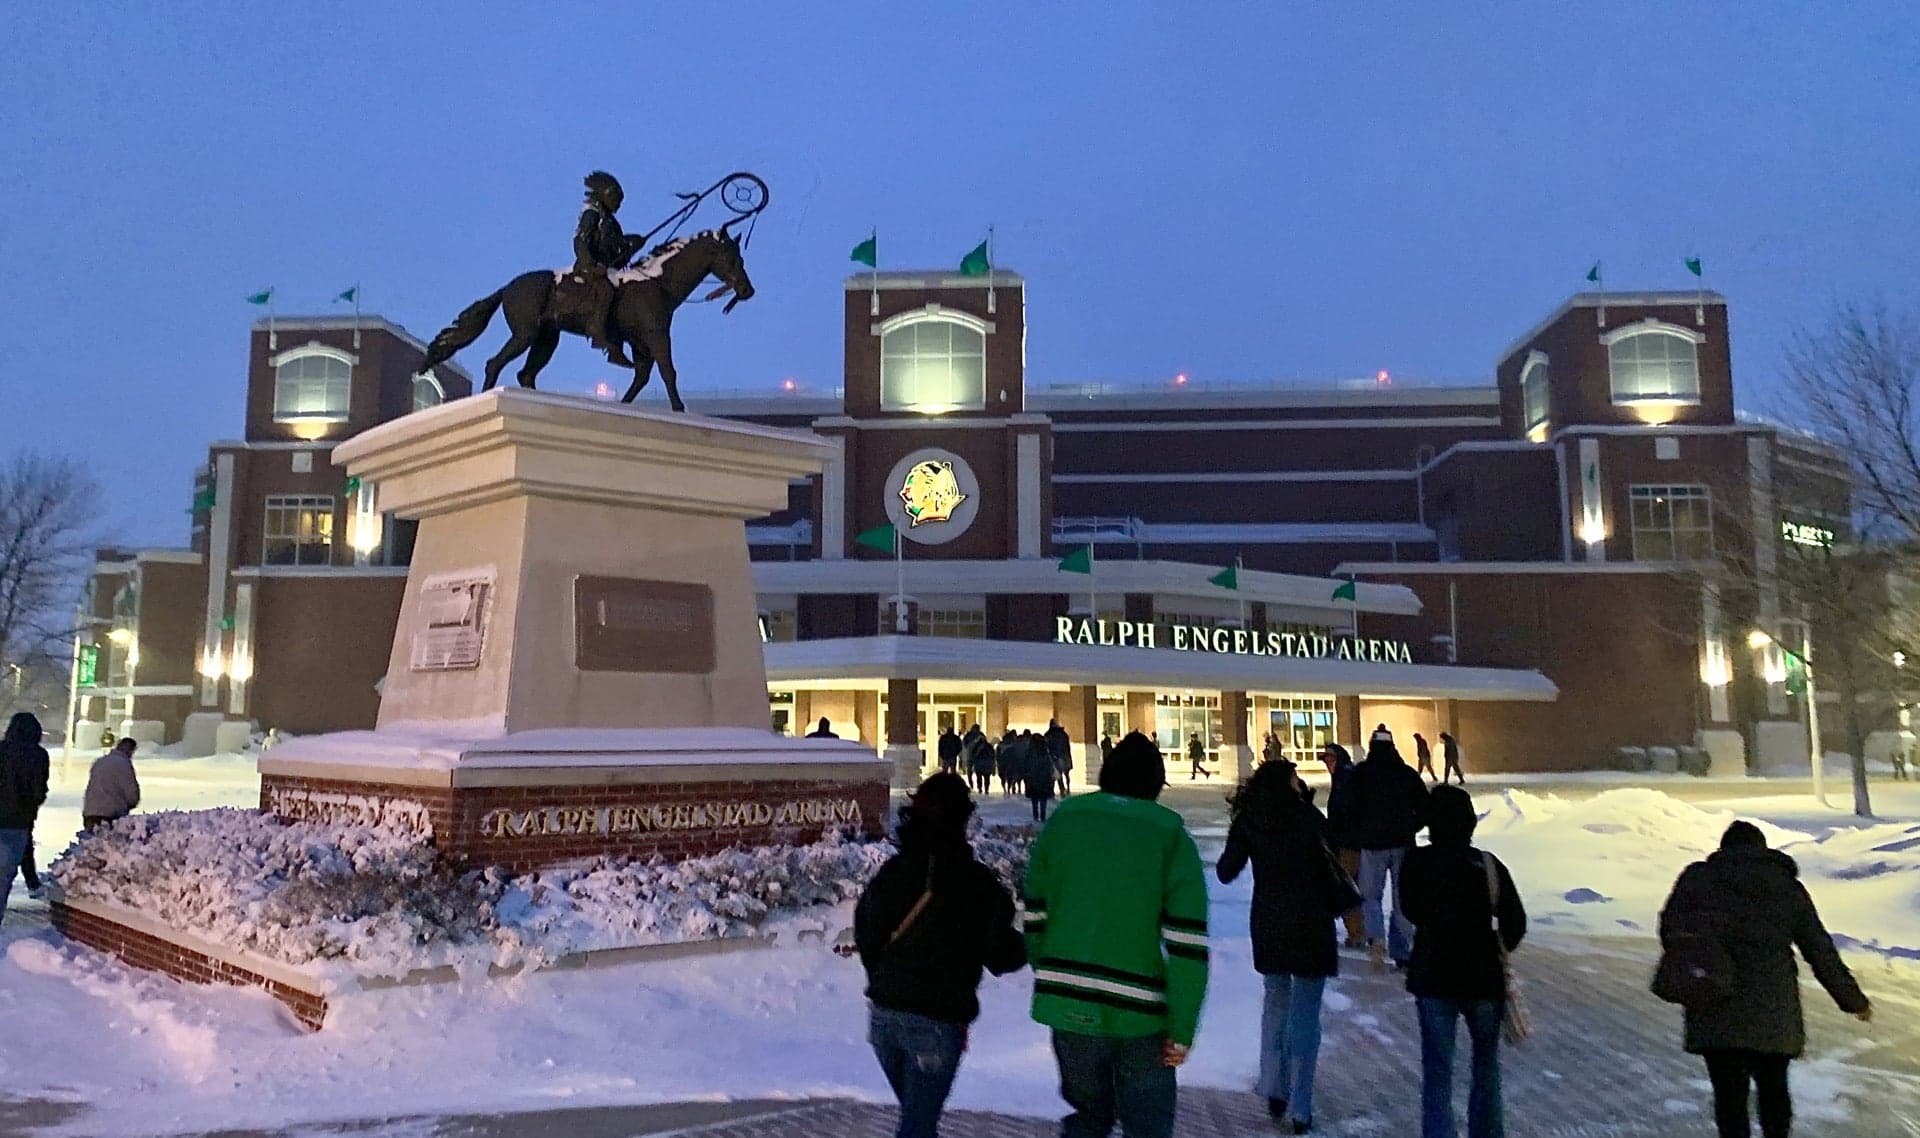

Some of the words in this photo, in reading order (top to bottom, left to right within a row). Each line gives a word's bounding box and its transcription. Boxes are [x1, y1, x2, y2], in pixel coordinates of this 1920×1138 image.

[1056, 616, 1155, 649] RALPH
[1173, 625, 1328, 659] ENGELSTAD
[1338, 637, 1413, 664] ARENA
[494, 806, 600, 838] RALPH
[611, 803, 772, 833] ENGELSTAD
[781, 799, 862, 825] ARENA
